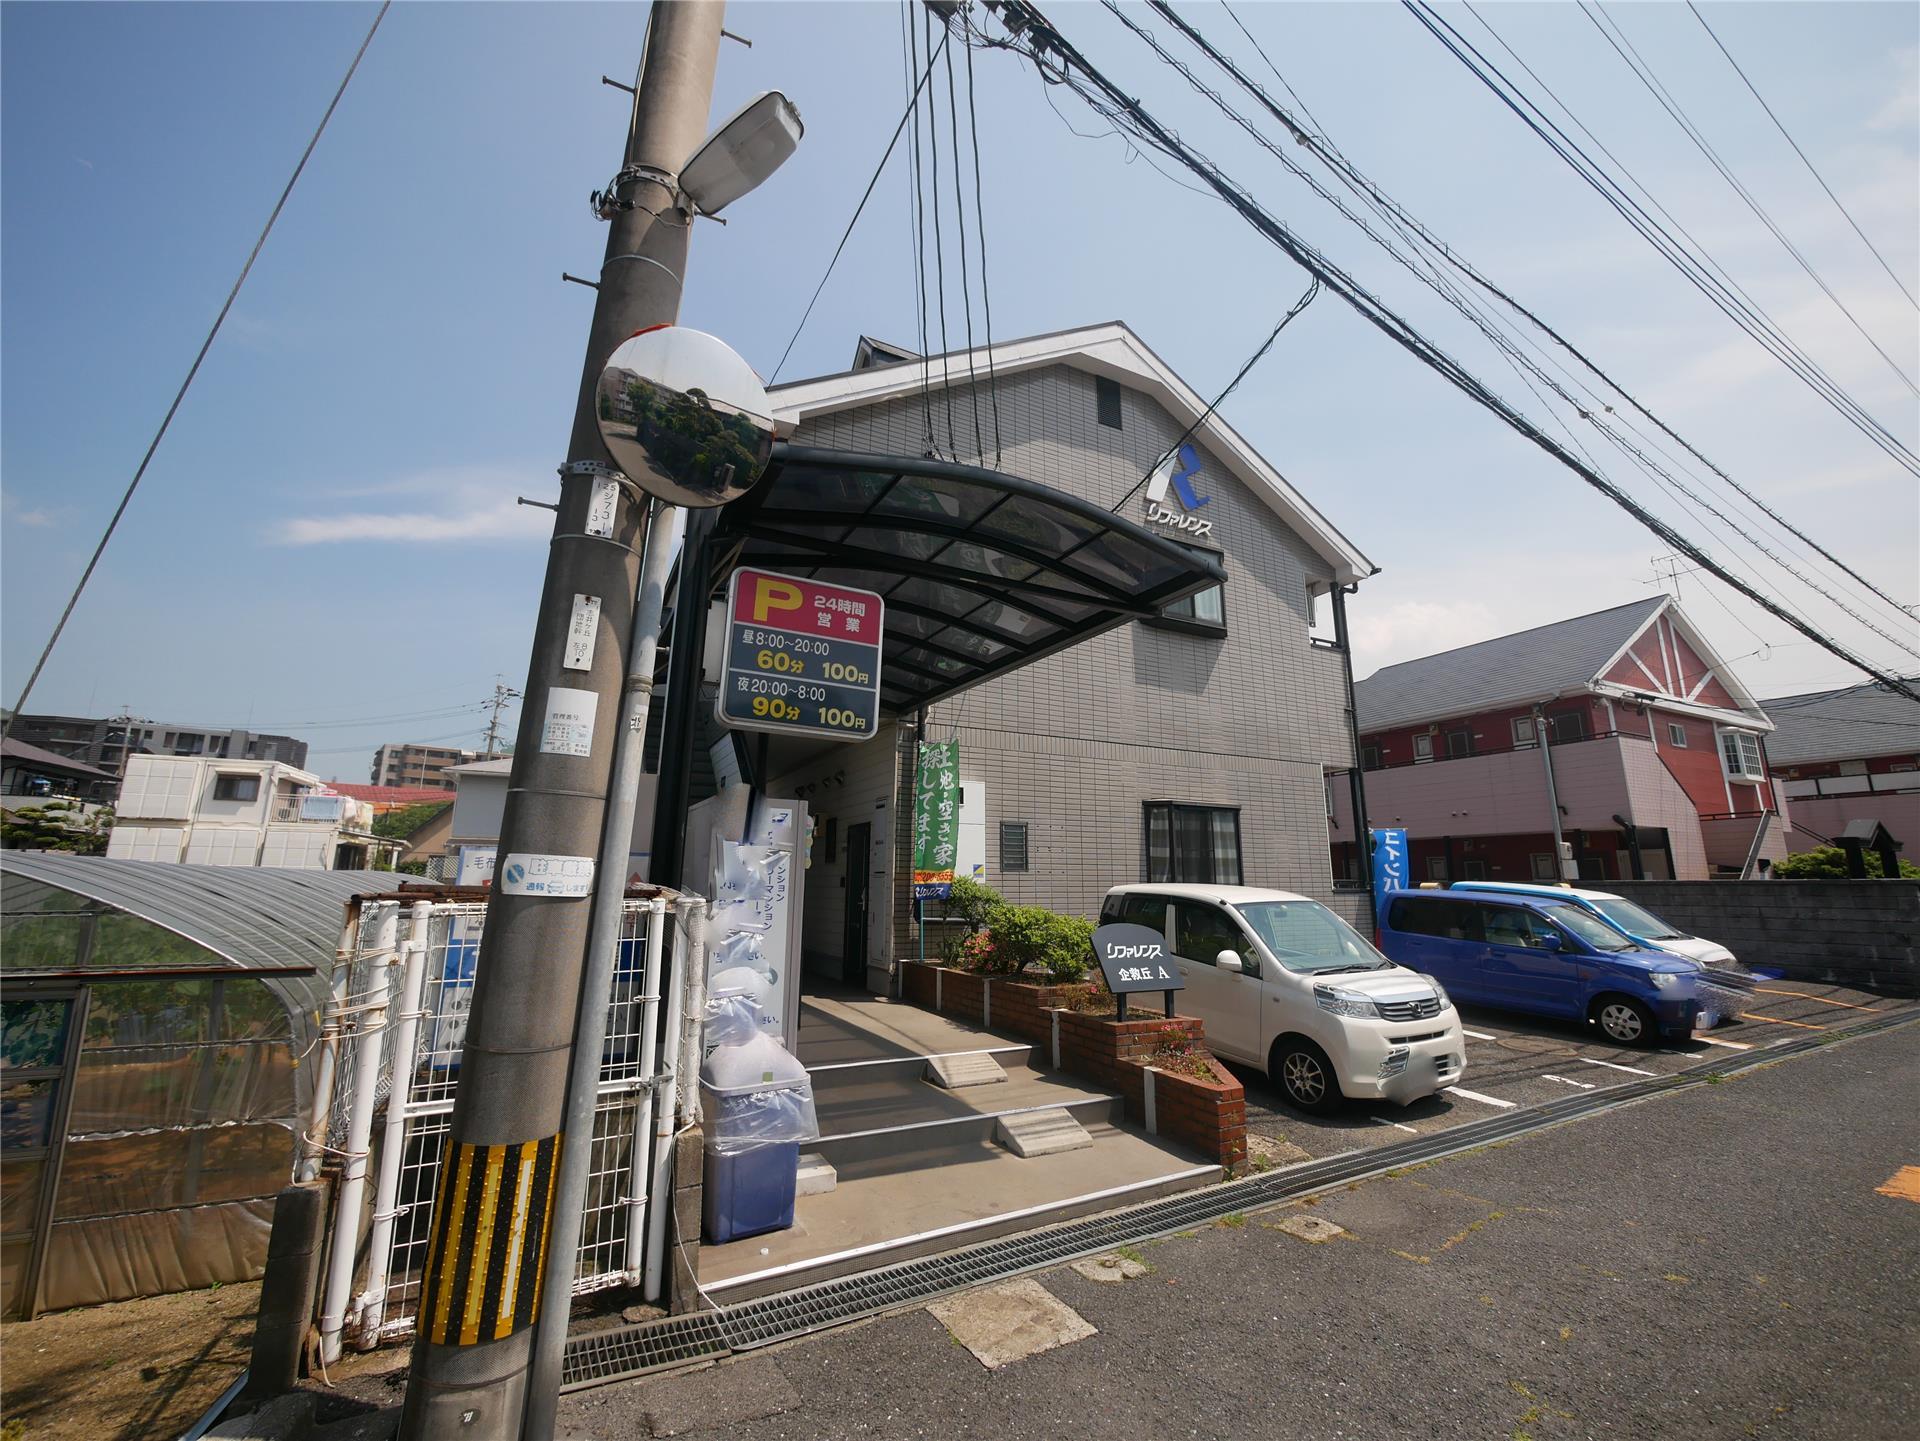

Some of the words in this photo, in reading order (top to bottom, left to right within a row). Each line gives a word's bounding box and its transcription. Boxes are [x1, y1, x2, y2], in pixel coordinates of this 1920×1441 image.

[1146, 502, 1213, 537] リファレンス
[753, 577, 804, 622] P
[814, 595, 867, 617] 24時間
[756, 649, 805, 674] 60分
[822, 662, 869, 684] 100円
[752, 696, 801, 721] 90分
[818, 707, 866, 729] 100円
[1107, 942, 1164, 960] リファレンス
[1118, 967, 1154, 982] 企救丘
[1158, 965, 1171, 979] A
